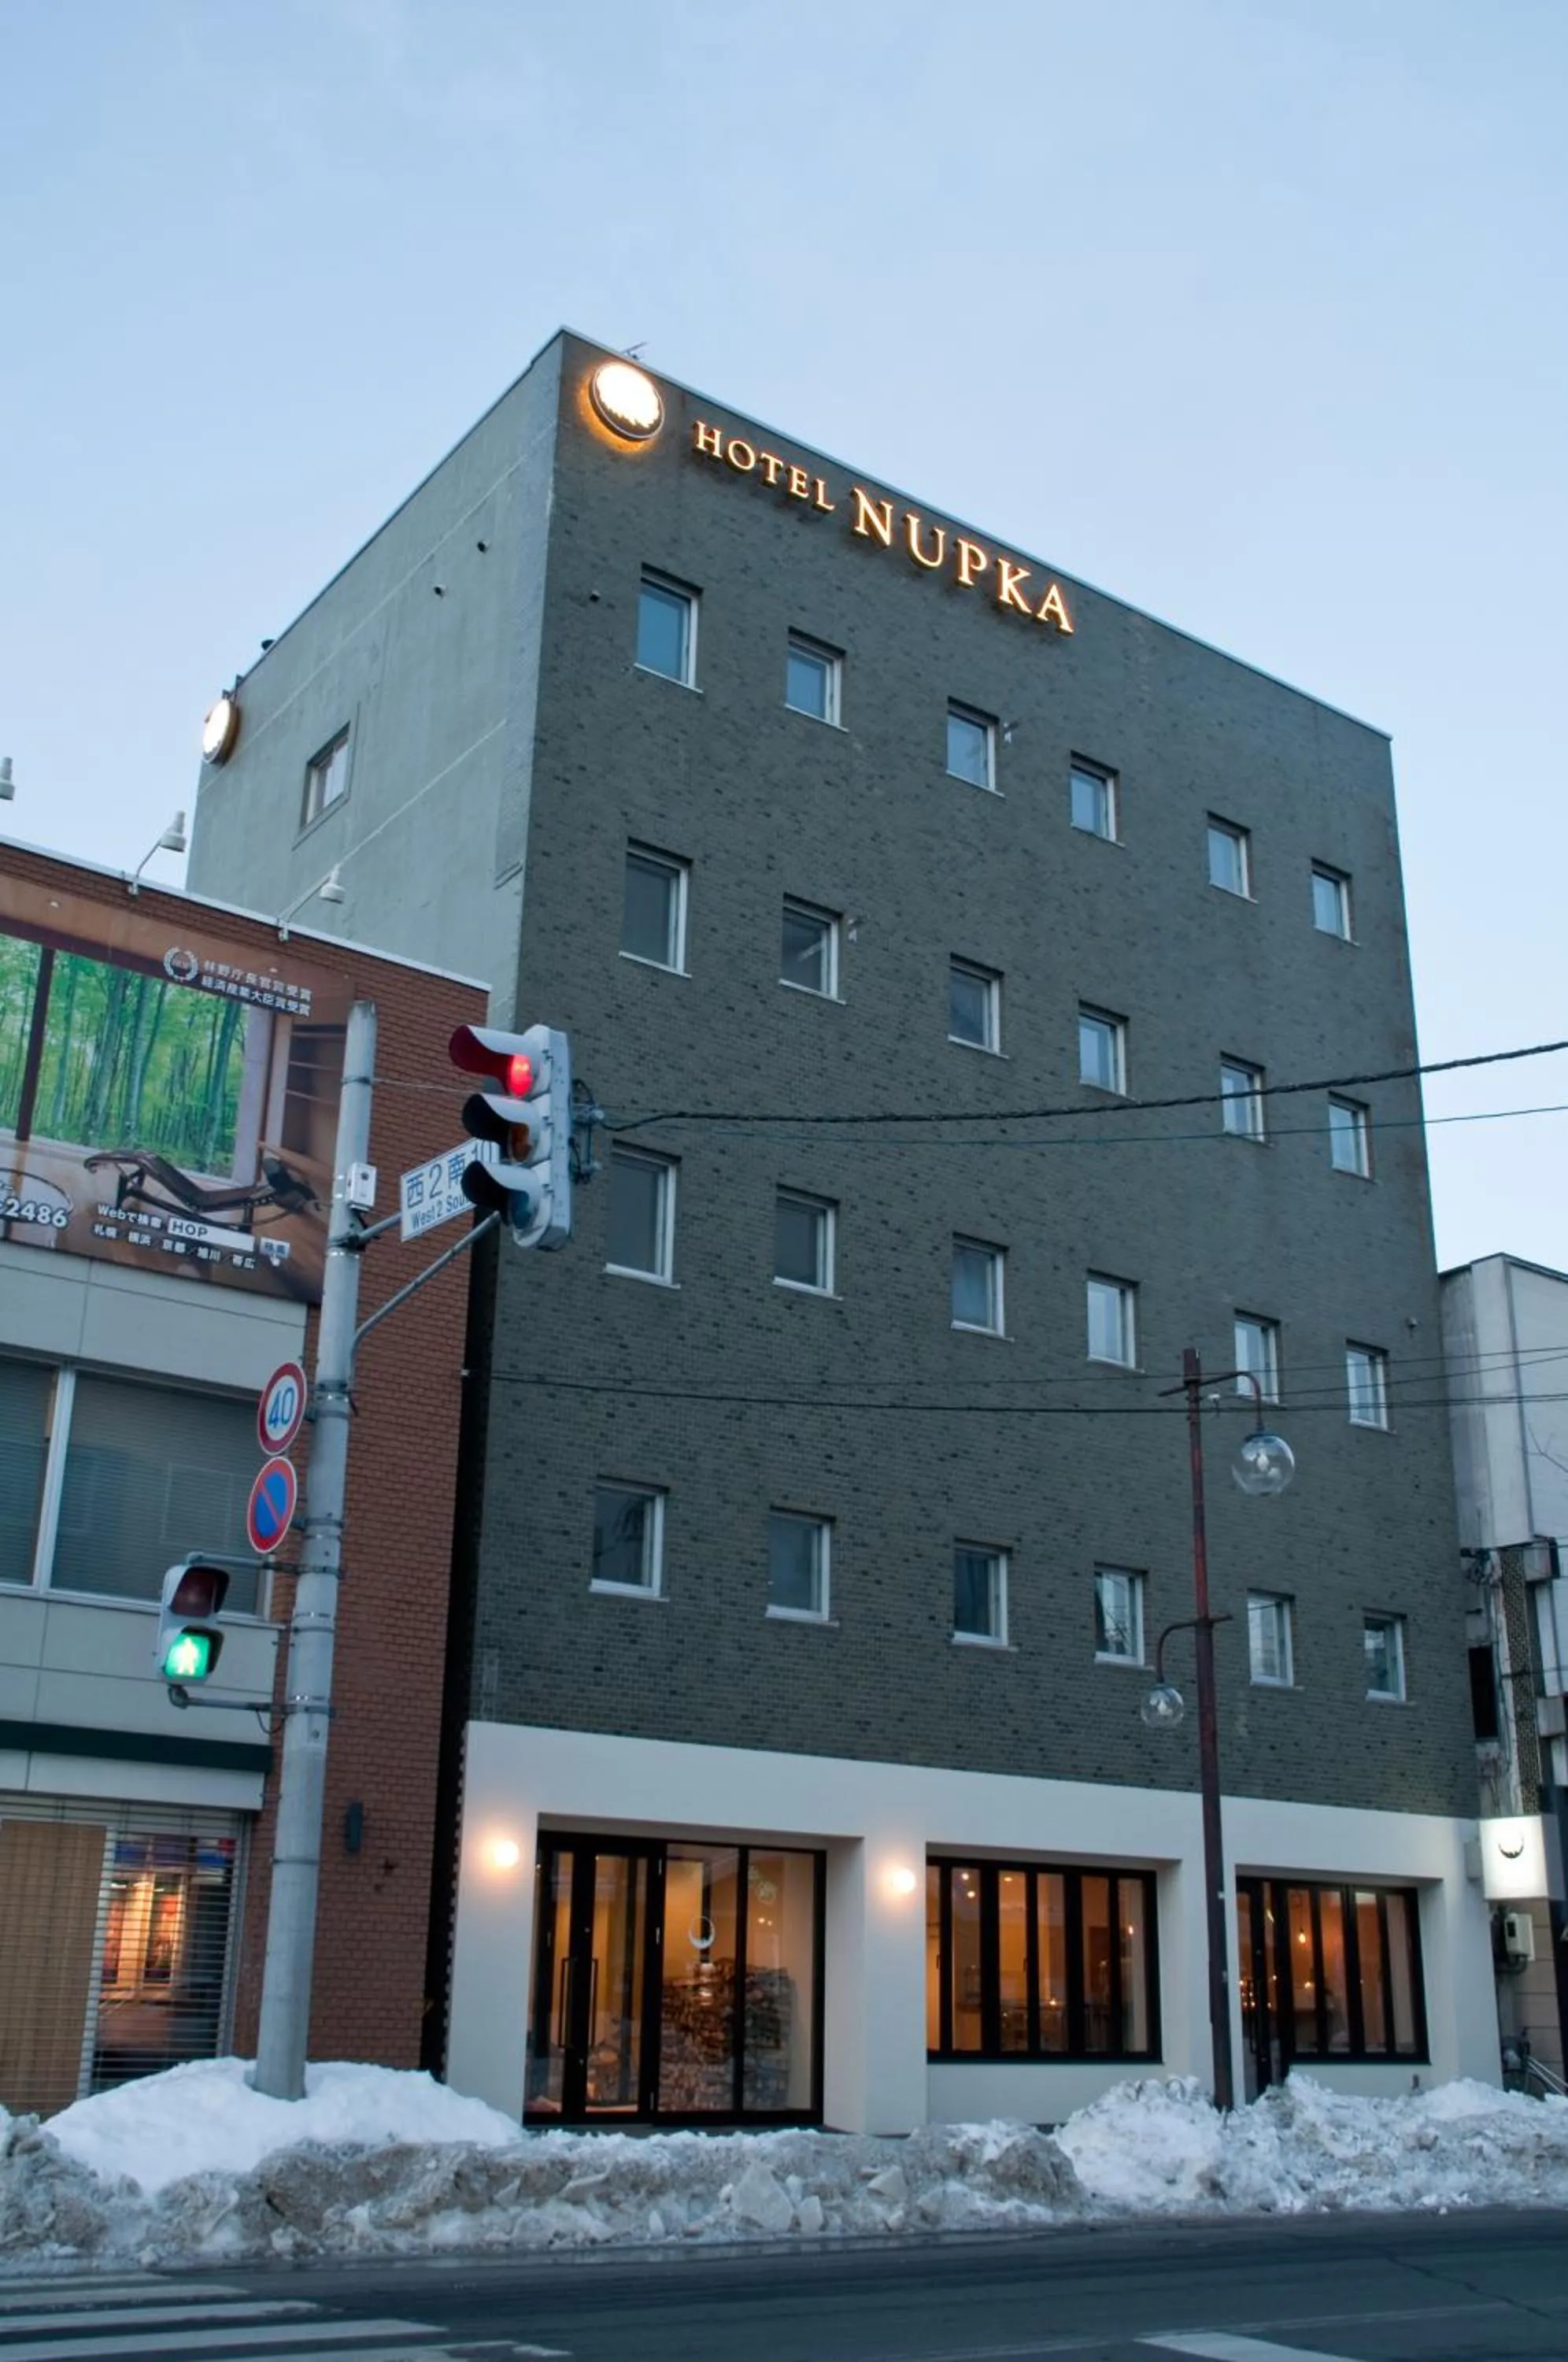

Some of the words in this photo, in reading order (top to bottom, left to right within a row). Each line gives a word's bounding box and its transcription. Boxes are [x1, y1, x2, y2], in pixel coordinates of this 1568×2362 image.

[693, 420, 836, 512] HOTEL
[849, 487, 1074, 635] NUPKA
[446, 1194, 466, 1212] Sou
[172, 1220, 209, 1237] HOP
[268, 1386, 295, 1429] 40
